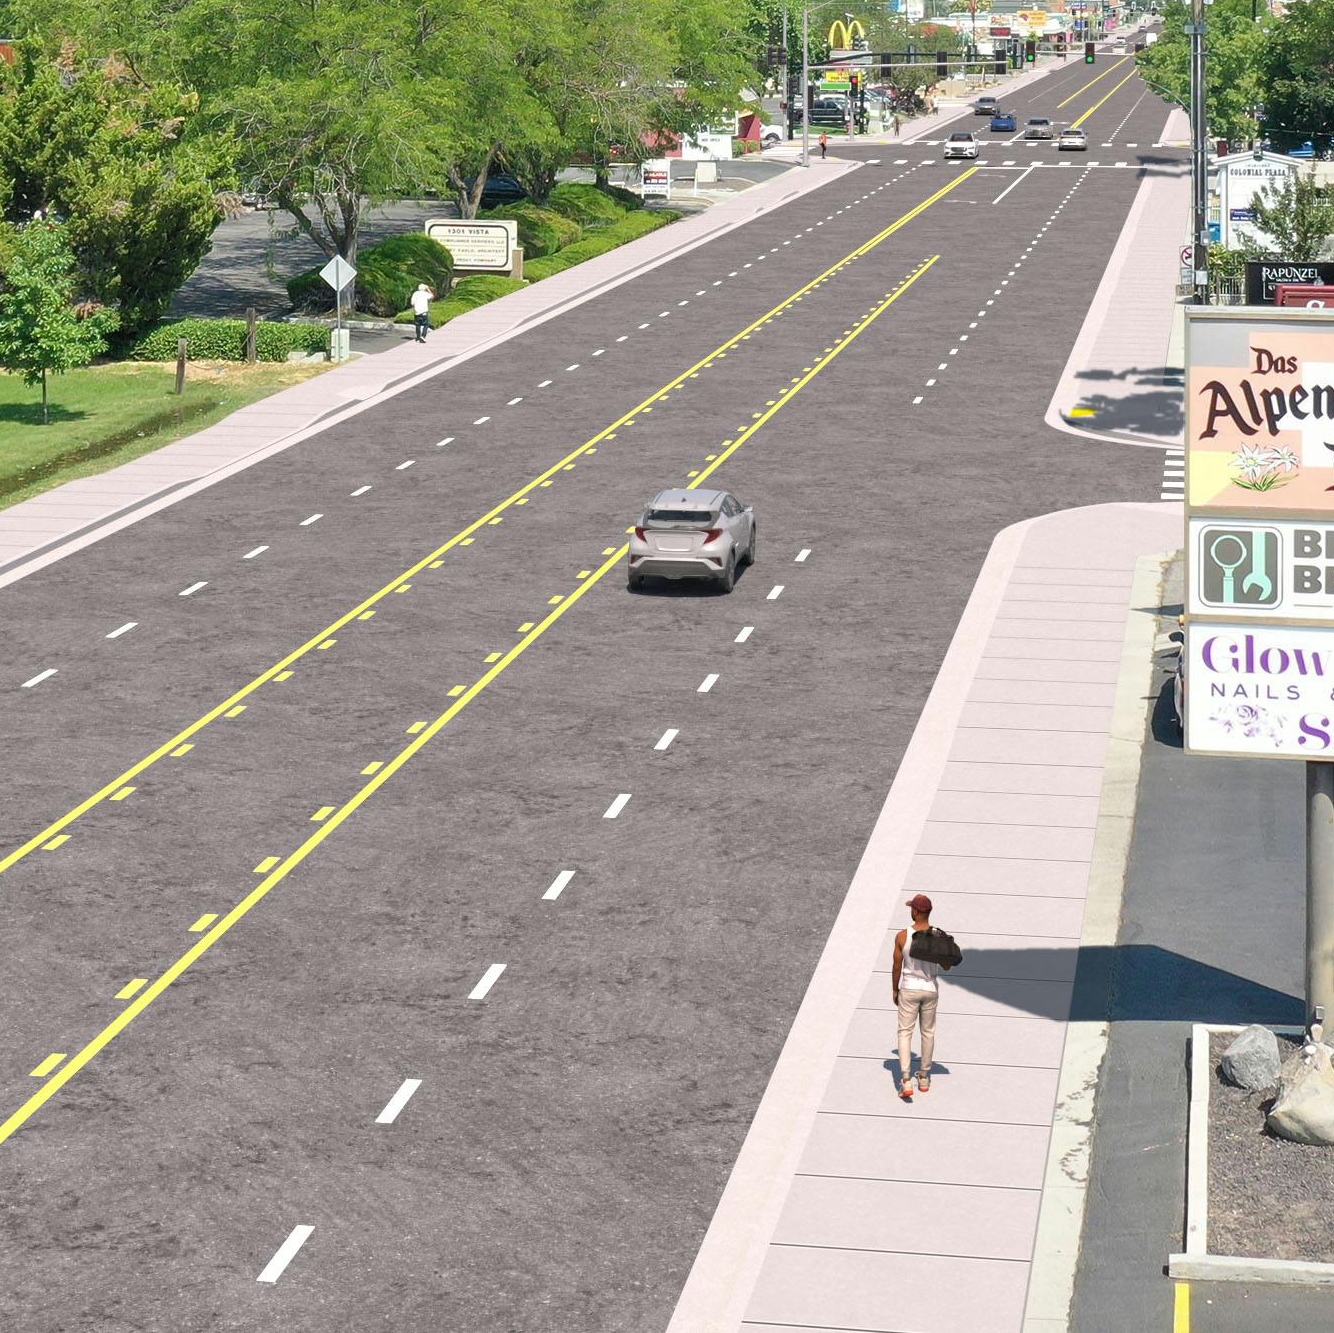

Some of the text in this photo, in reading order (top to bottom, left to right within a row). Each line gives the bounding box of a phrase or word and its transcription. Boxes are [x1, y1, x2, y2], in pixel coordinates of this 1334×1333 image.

[1230, 168, 1286, 176] COLONIAL PLAZA
[1250, 345, 1299, 376] Das
[1201, 634, 1332, 676] Glow
[1210, 682, 1301, 701] NAILS
